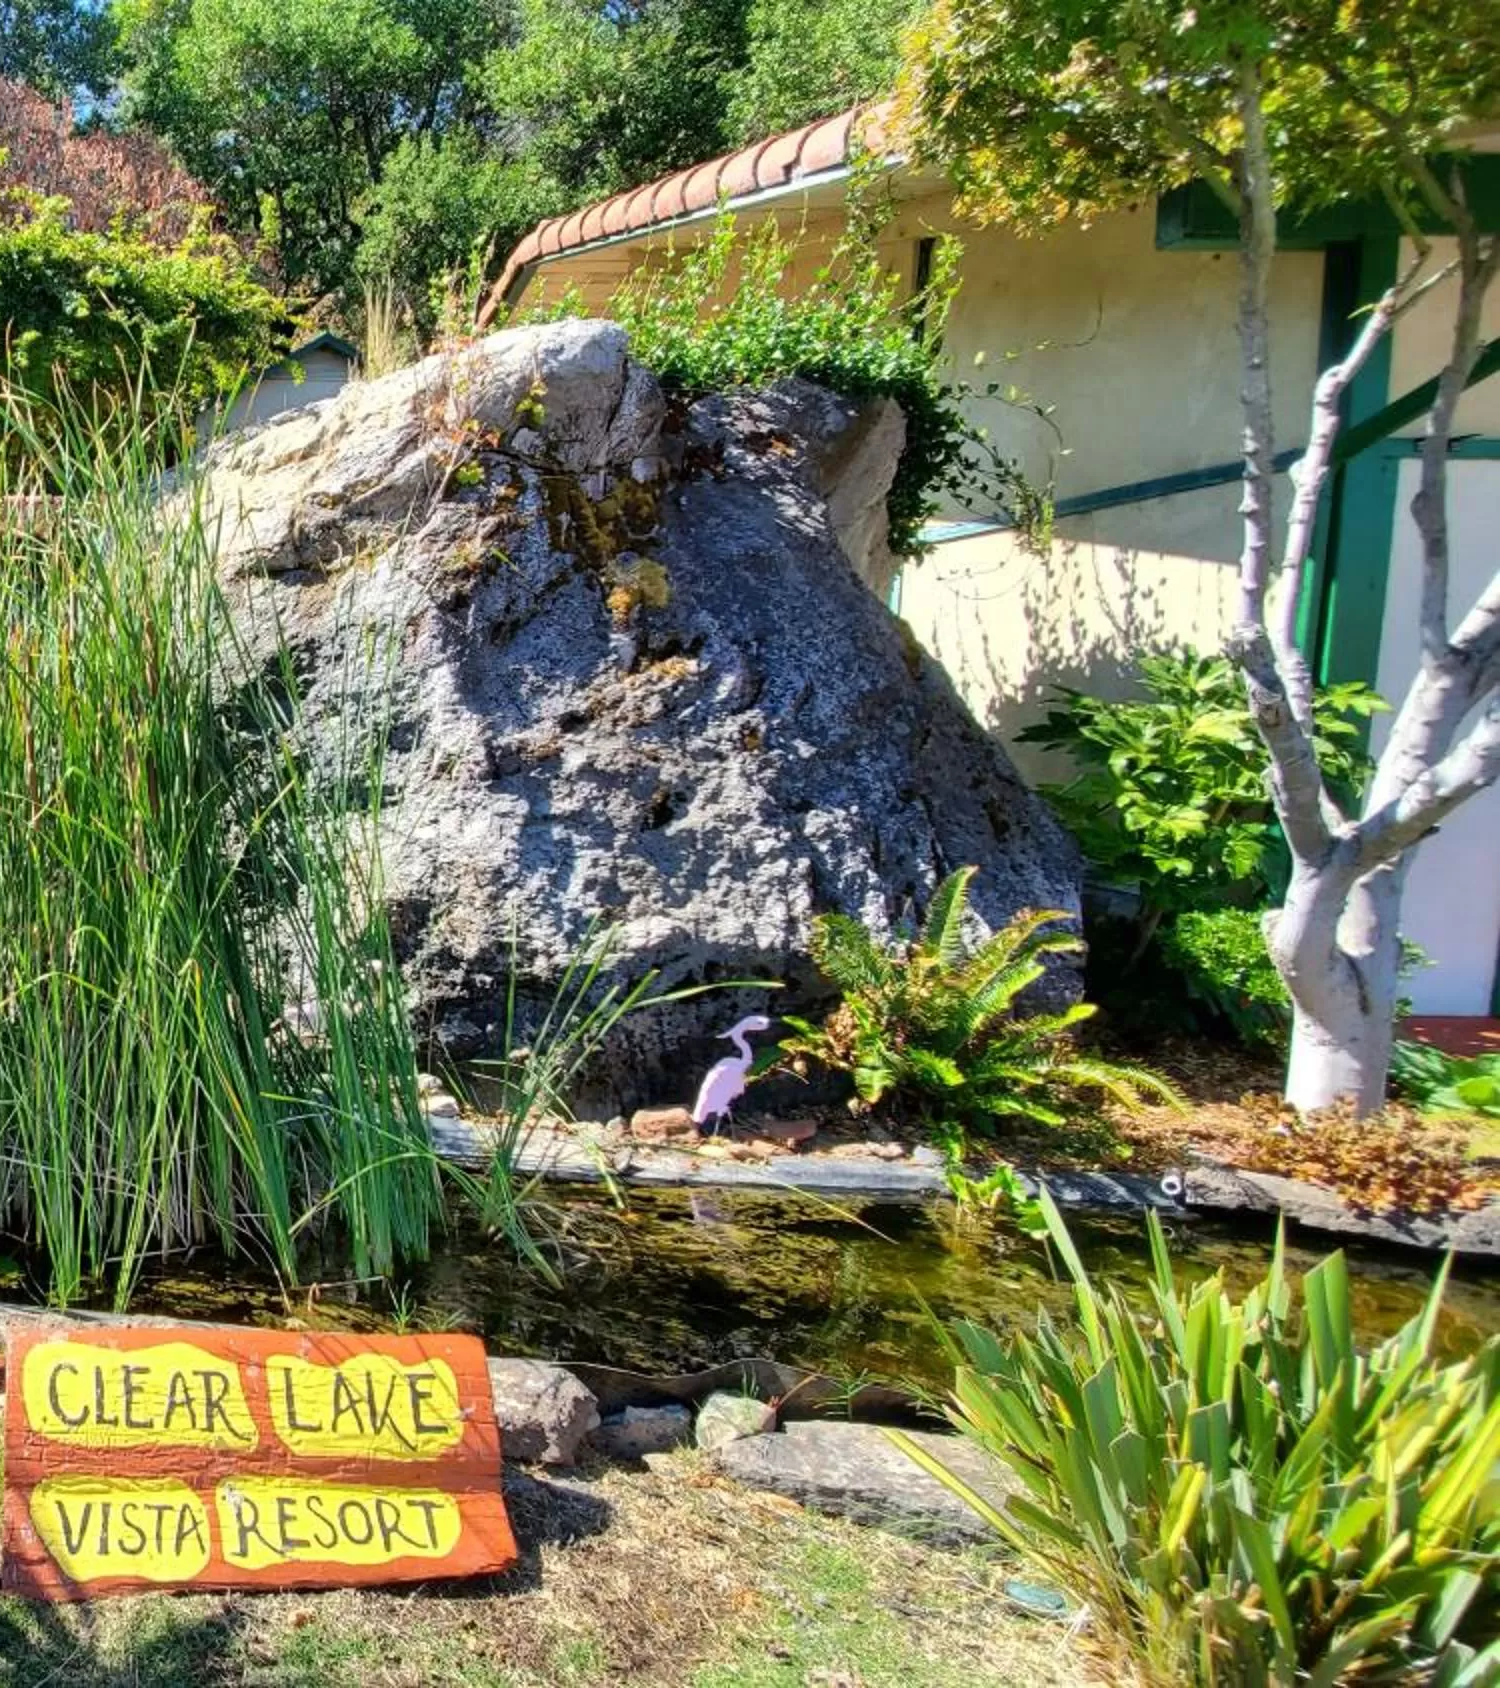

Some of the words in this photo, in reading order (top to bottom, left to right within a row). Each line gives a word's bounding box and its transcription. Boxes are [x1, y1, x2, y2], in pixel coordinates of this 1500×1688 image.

[49, 1363, 253, 1441] CLEAR
[283, 1367, 449, 1451] LAKE
[55, 1500, 206, 1556] VISTA
[229, 1495, 444, 1557] RESORT
